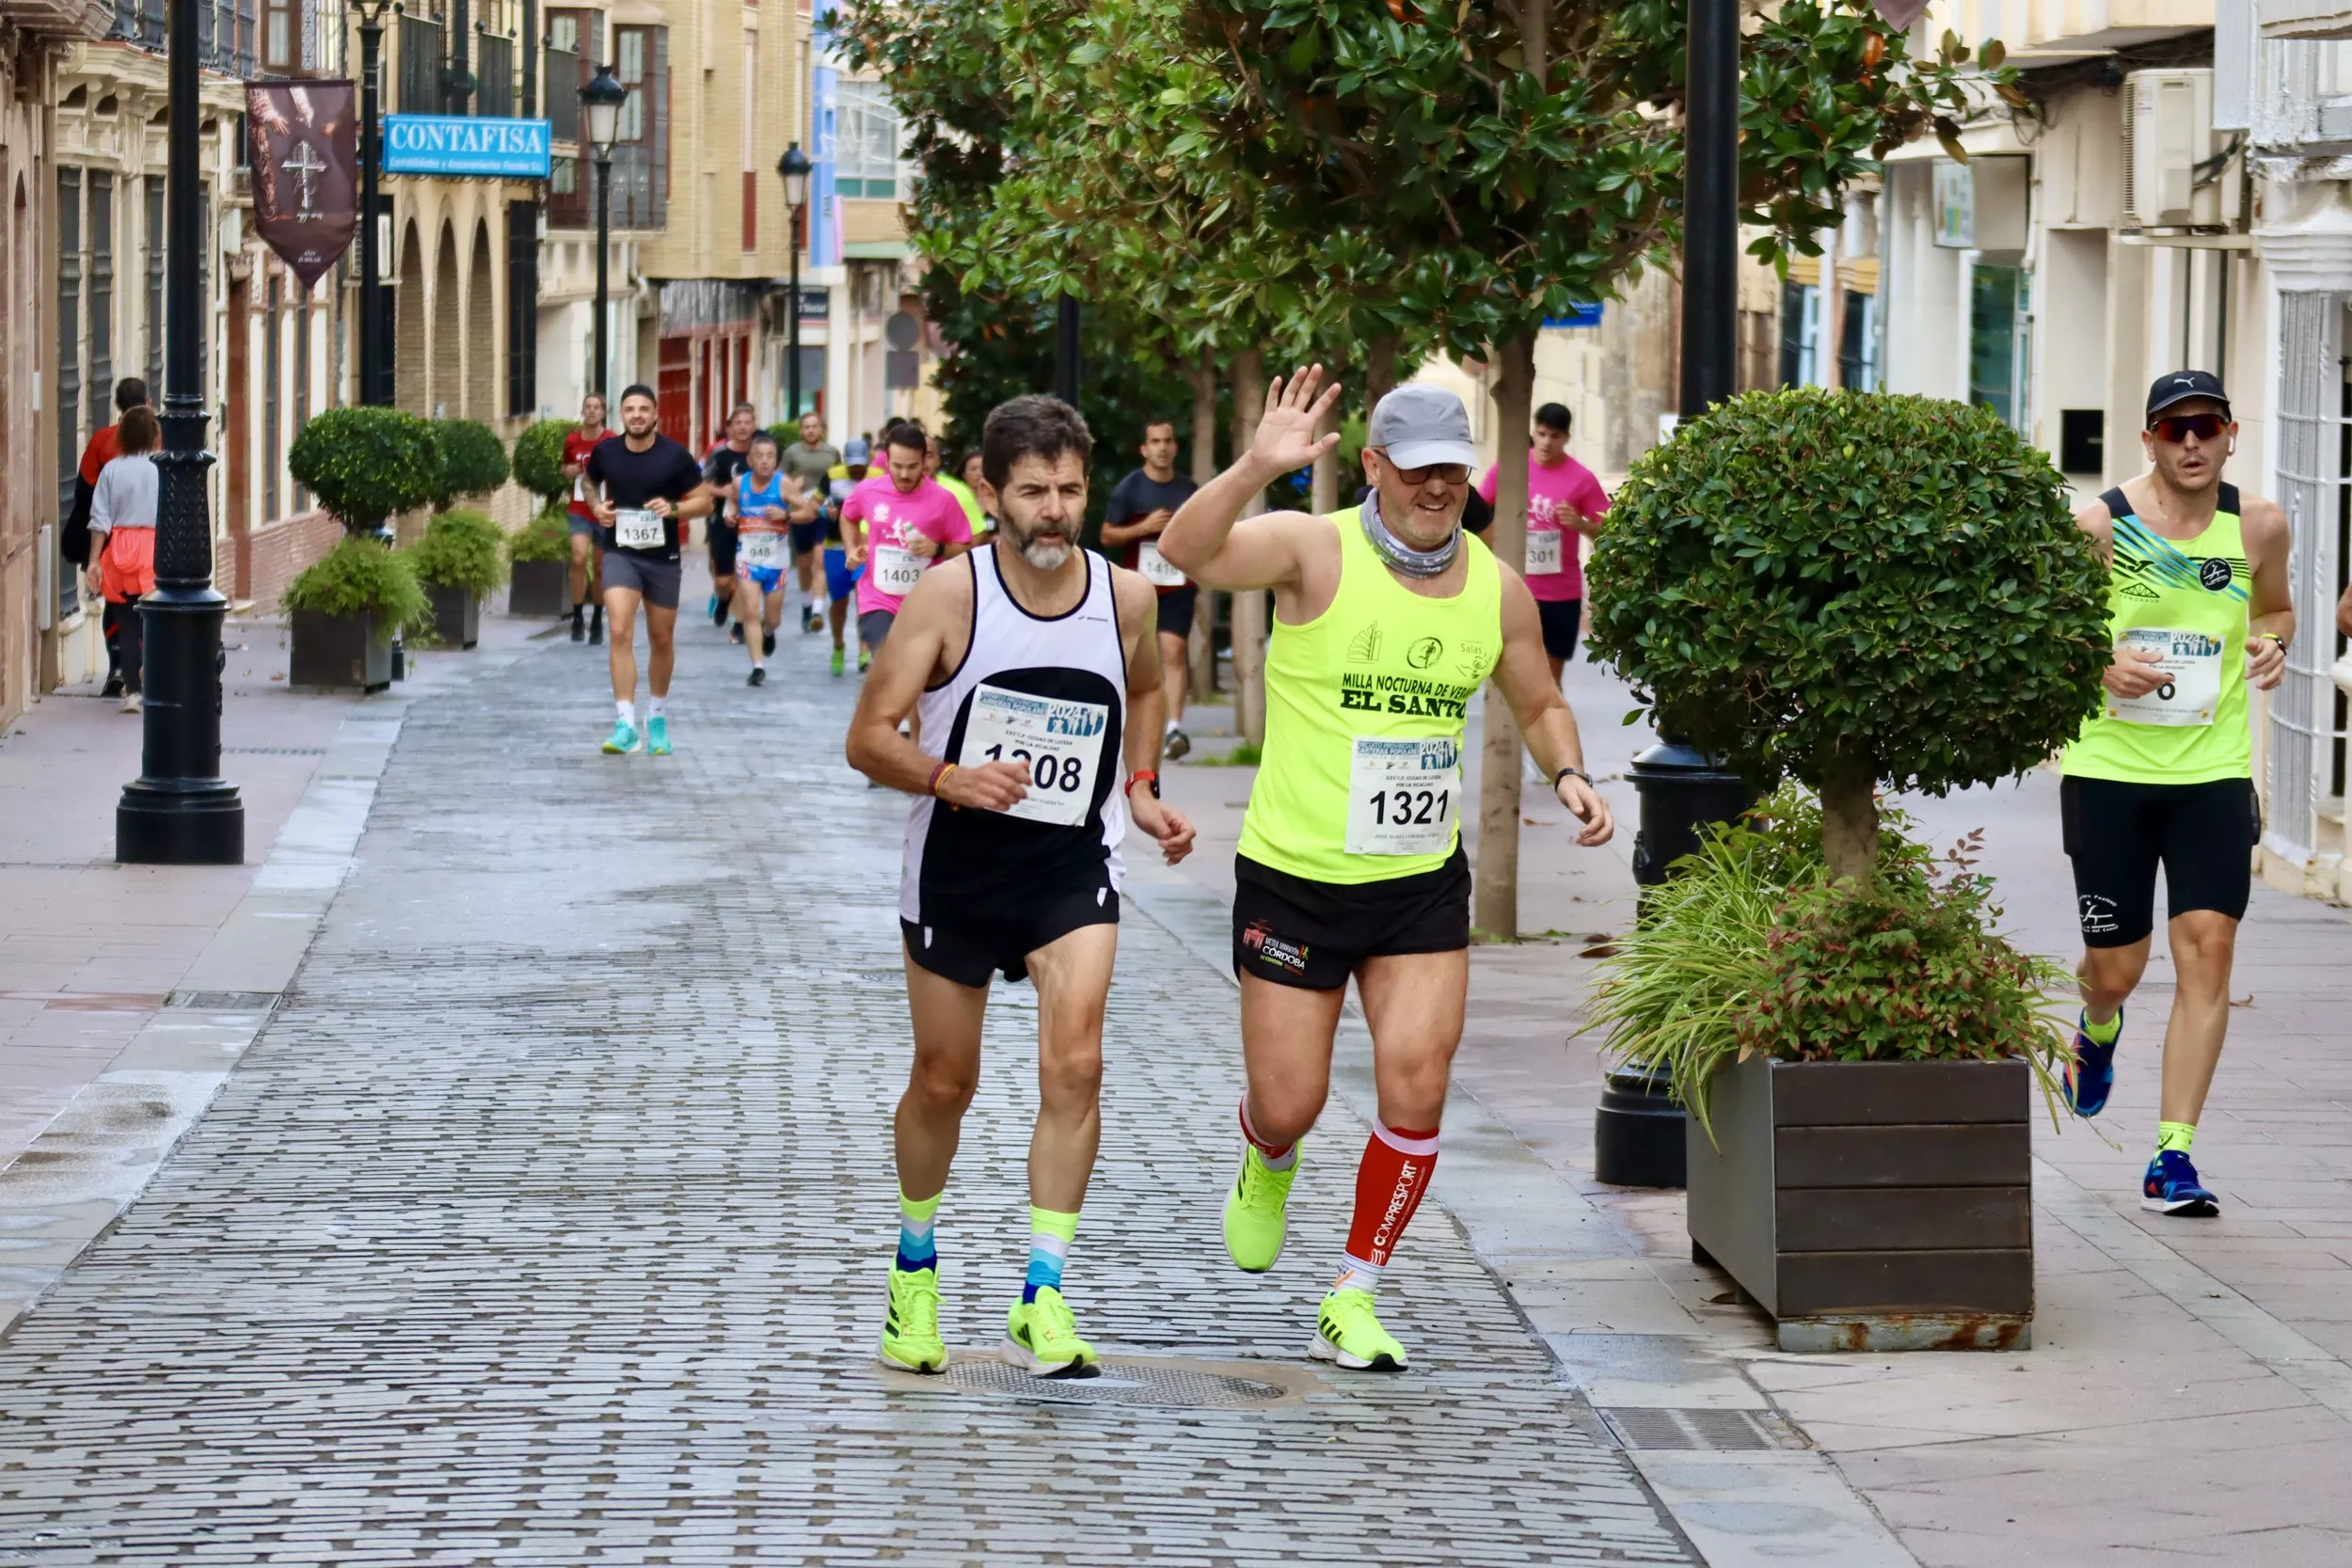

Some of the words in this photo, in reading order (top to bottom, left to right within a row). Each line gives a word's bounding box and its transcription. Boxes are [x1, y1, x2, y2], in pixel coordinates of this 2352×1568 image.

[390, 123, 543, 154] CONTAFISA
[624, 527, 659, 542] 1367
[749, 546, 771, 558] 948
[882, 568, 920, 583] 1403
[2171, 632, 2199, 644] 2024
[1460, 642, 1483, 655] Salas
[1343, 673, 1373, 689] MILLA
[1375, 675, 1433, 696] NOCTURNA
[1434, 683, 1450, 697] DE
[1340, 689, 1381, 712] EL
[1049, 703, 1082, 720] 2024
[1421, 741, 1445, 754] 2024
[1370, 789, 1449, 826] 1321
[1262, 945, 1305, 971] CÓRDOBA
